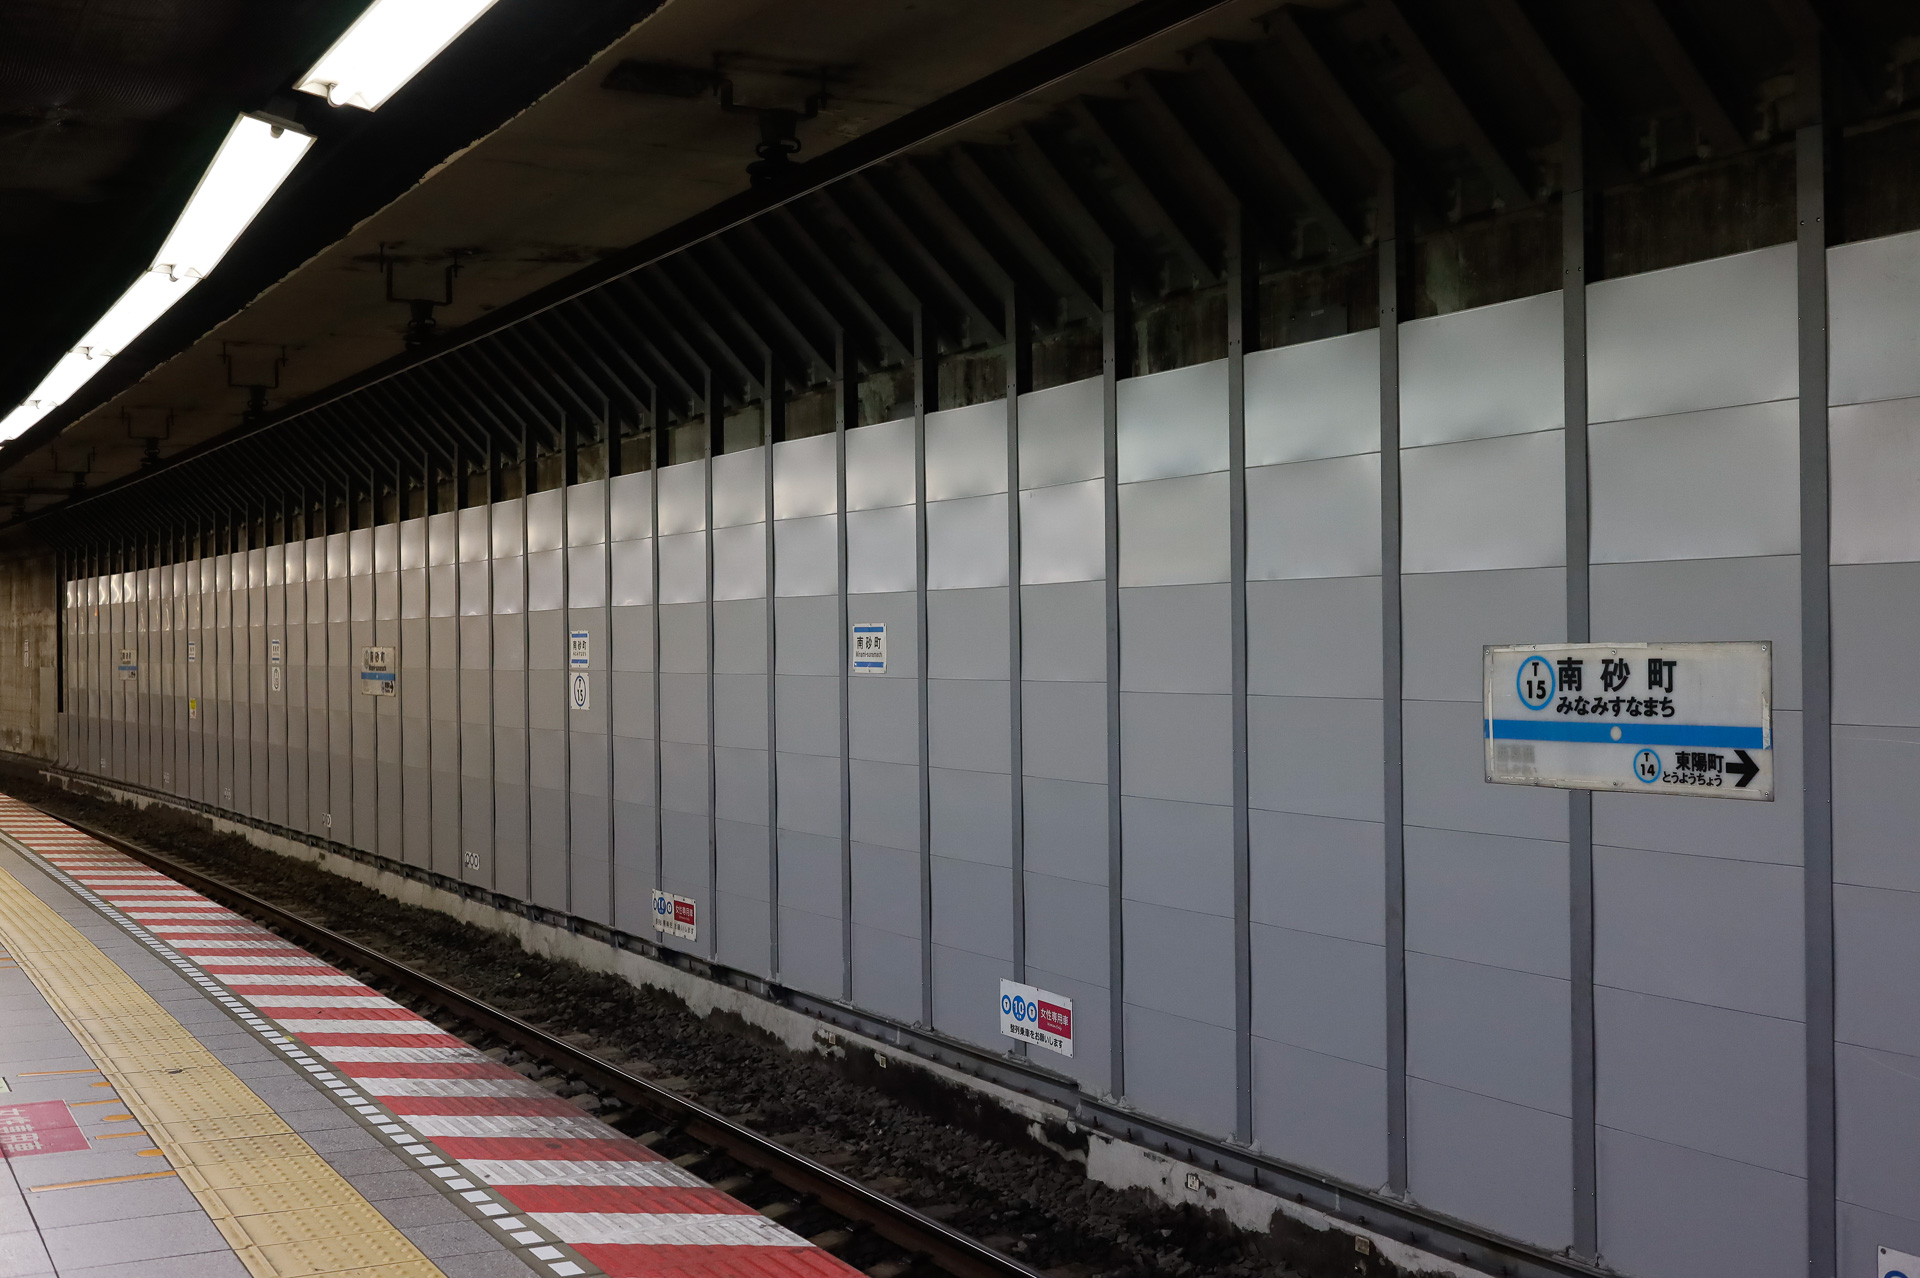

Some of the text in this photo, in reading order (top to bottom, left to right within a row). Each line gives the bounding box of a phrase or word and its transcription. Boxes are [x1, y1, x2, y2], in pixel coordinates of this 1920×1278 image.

[857, 636, 881, 649] 南砂町
[1531, 662, 1539, 676] T
[1557, 657, 1677, 693] 南砂町
[1526, 680, 1546, 699] 15
[1556, 695, 1675, 717] みなみすなまち
[1644, 752, 1649, 762] T
[1675, 751, 1724, 773] 東陽町
[1640, 764, 1655, 776] 14
[1662, 771, 1722, 786] とうようちょう
[1013, 1000, 1025, 1014] 10
[1041, 1008, 1068, 1026] 女性専用車
